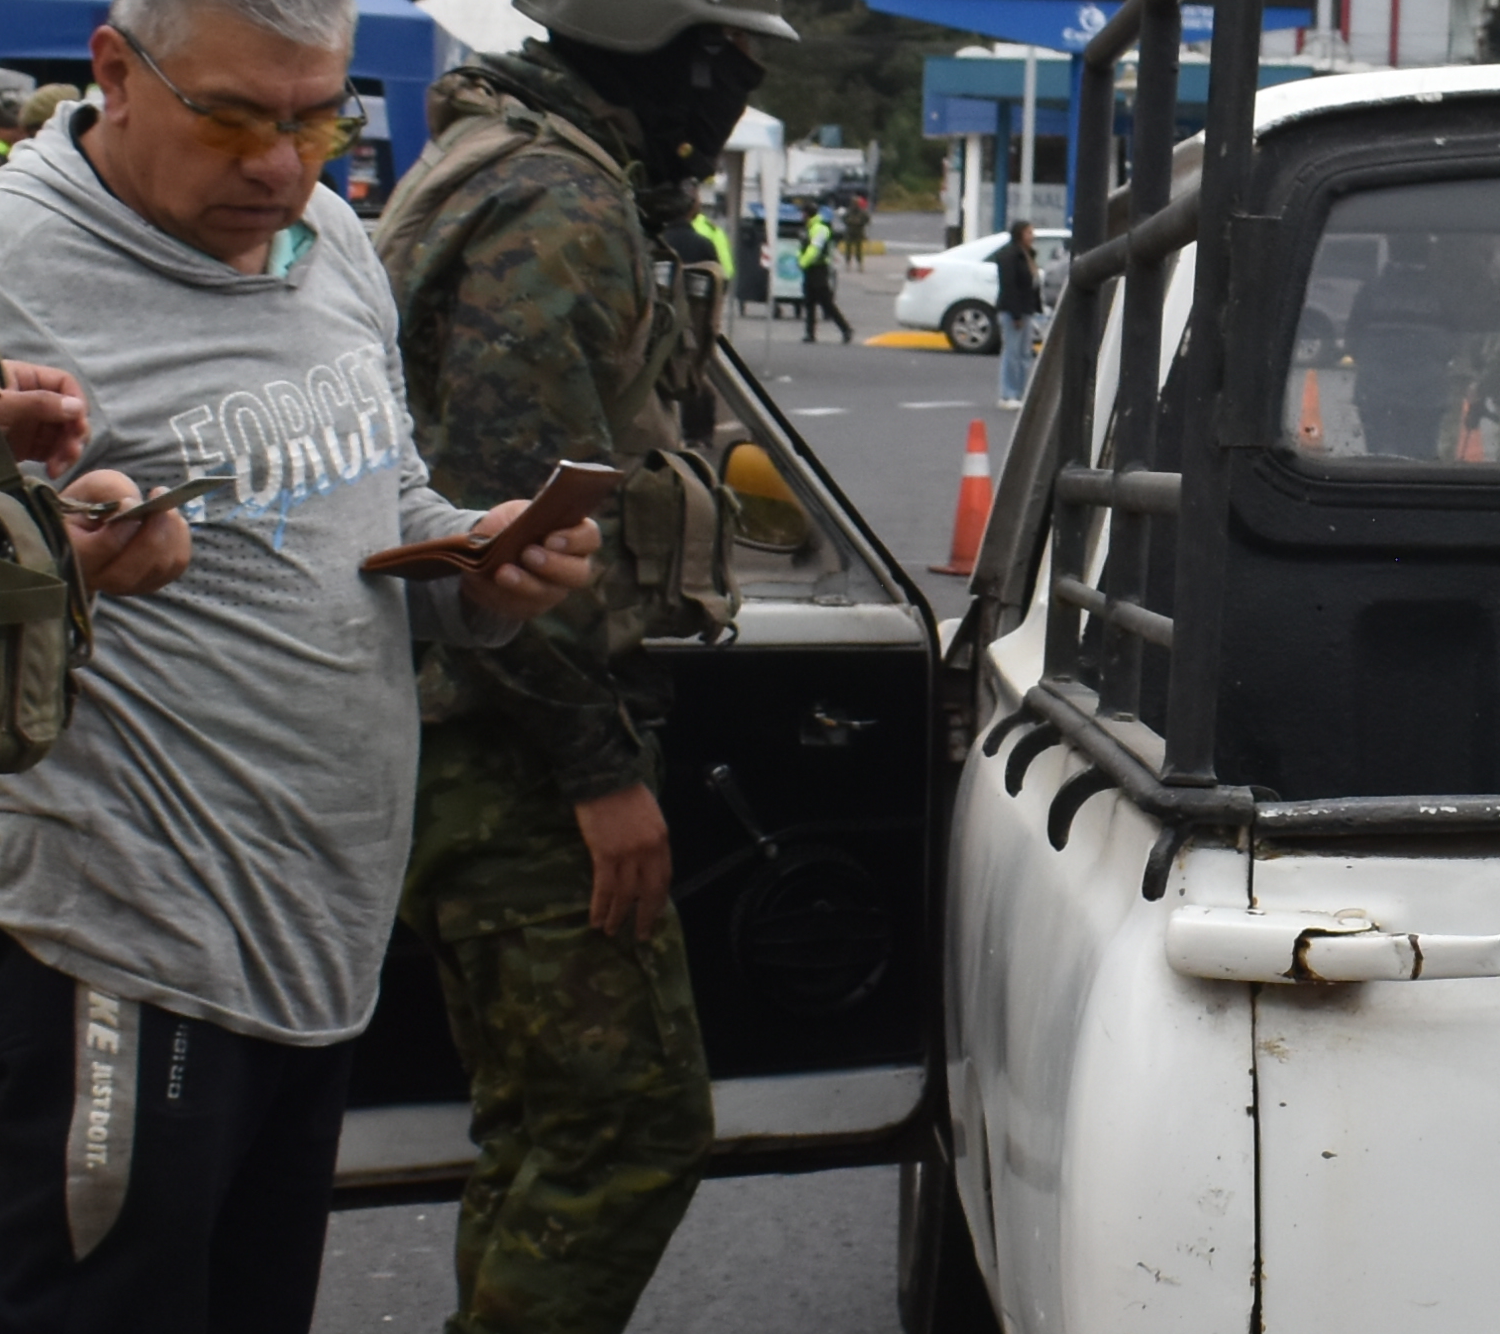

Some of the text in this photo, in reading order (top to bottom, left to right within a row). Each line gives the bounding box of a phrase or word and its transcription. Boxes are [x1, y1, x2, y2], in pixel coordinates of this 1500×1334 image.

[86, 990, 121, 1055] KE
[91, 1060, 114, 1109] JUST
[87, 1111, 111, 1142] DO
